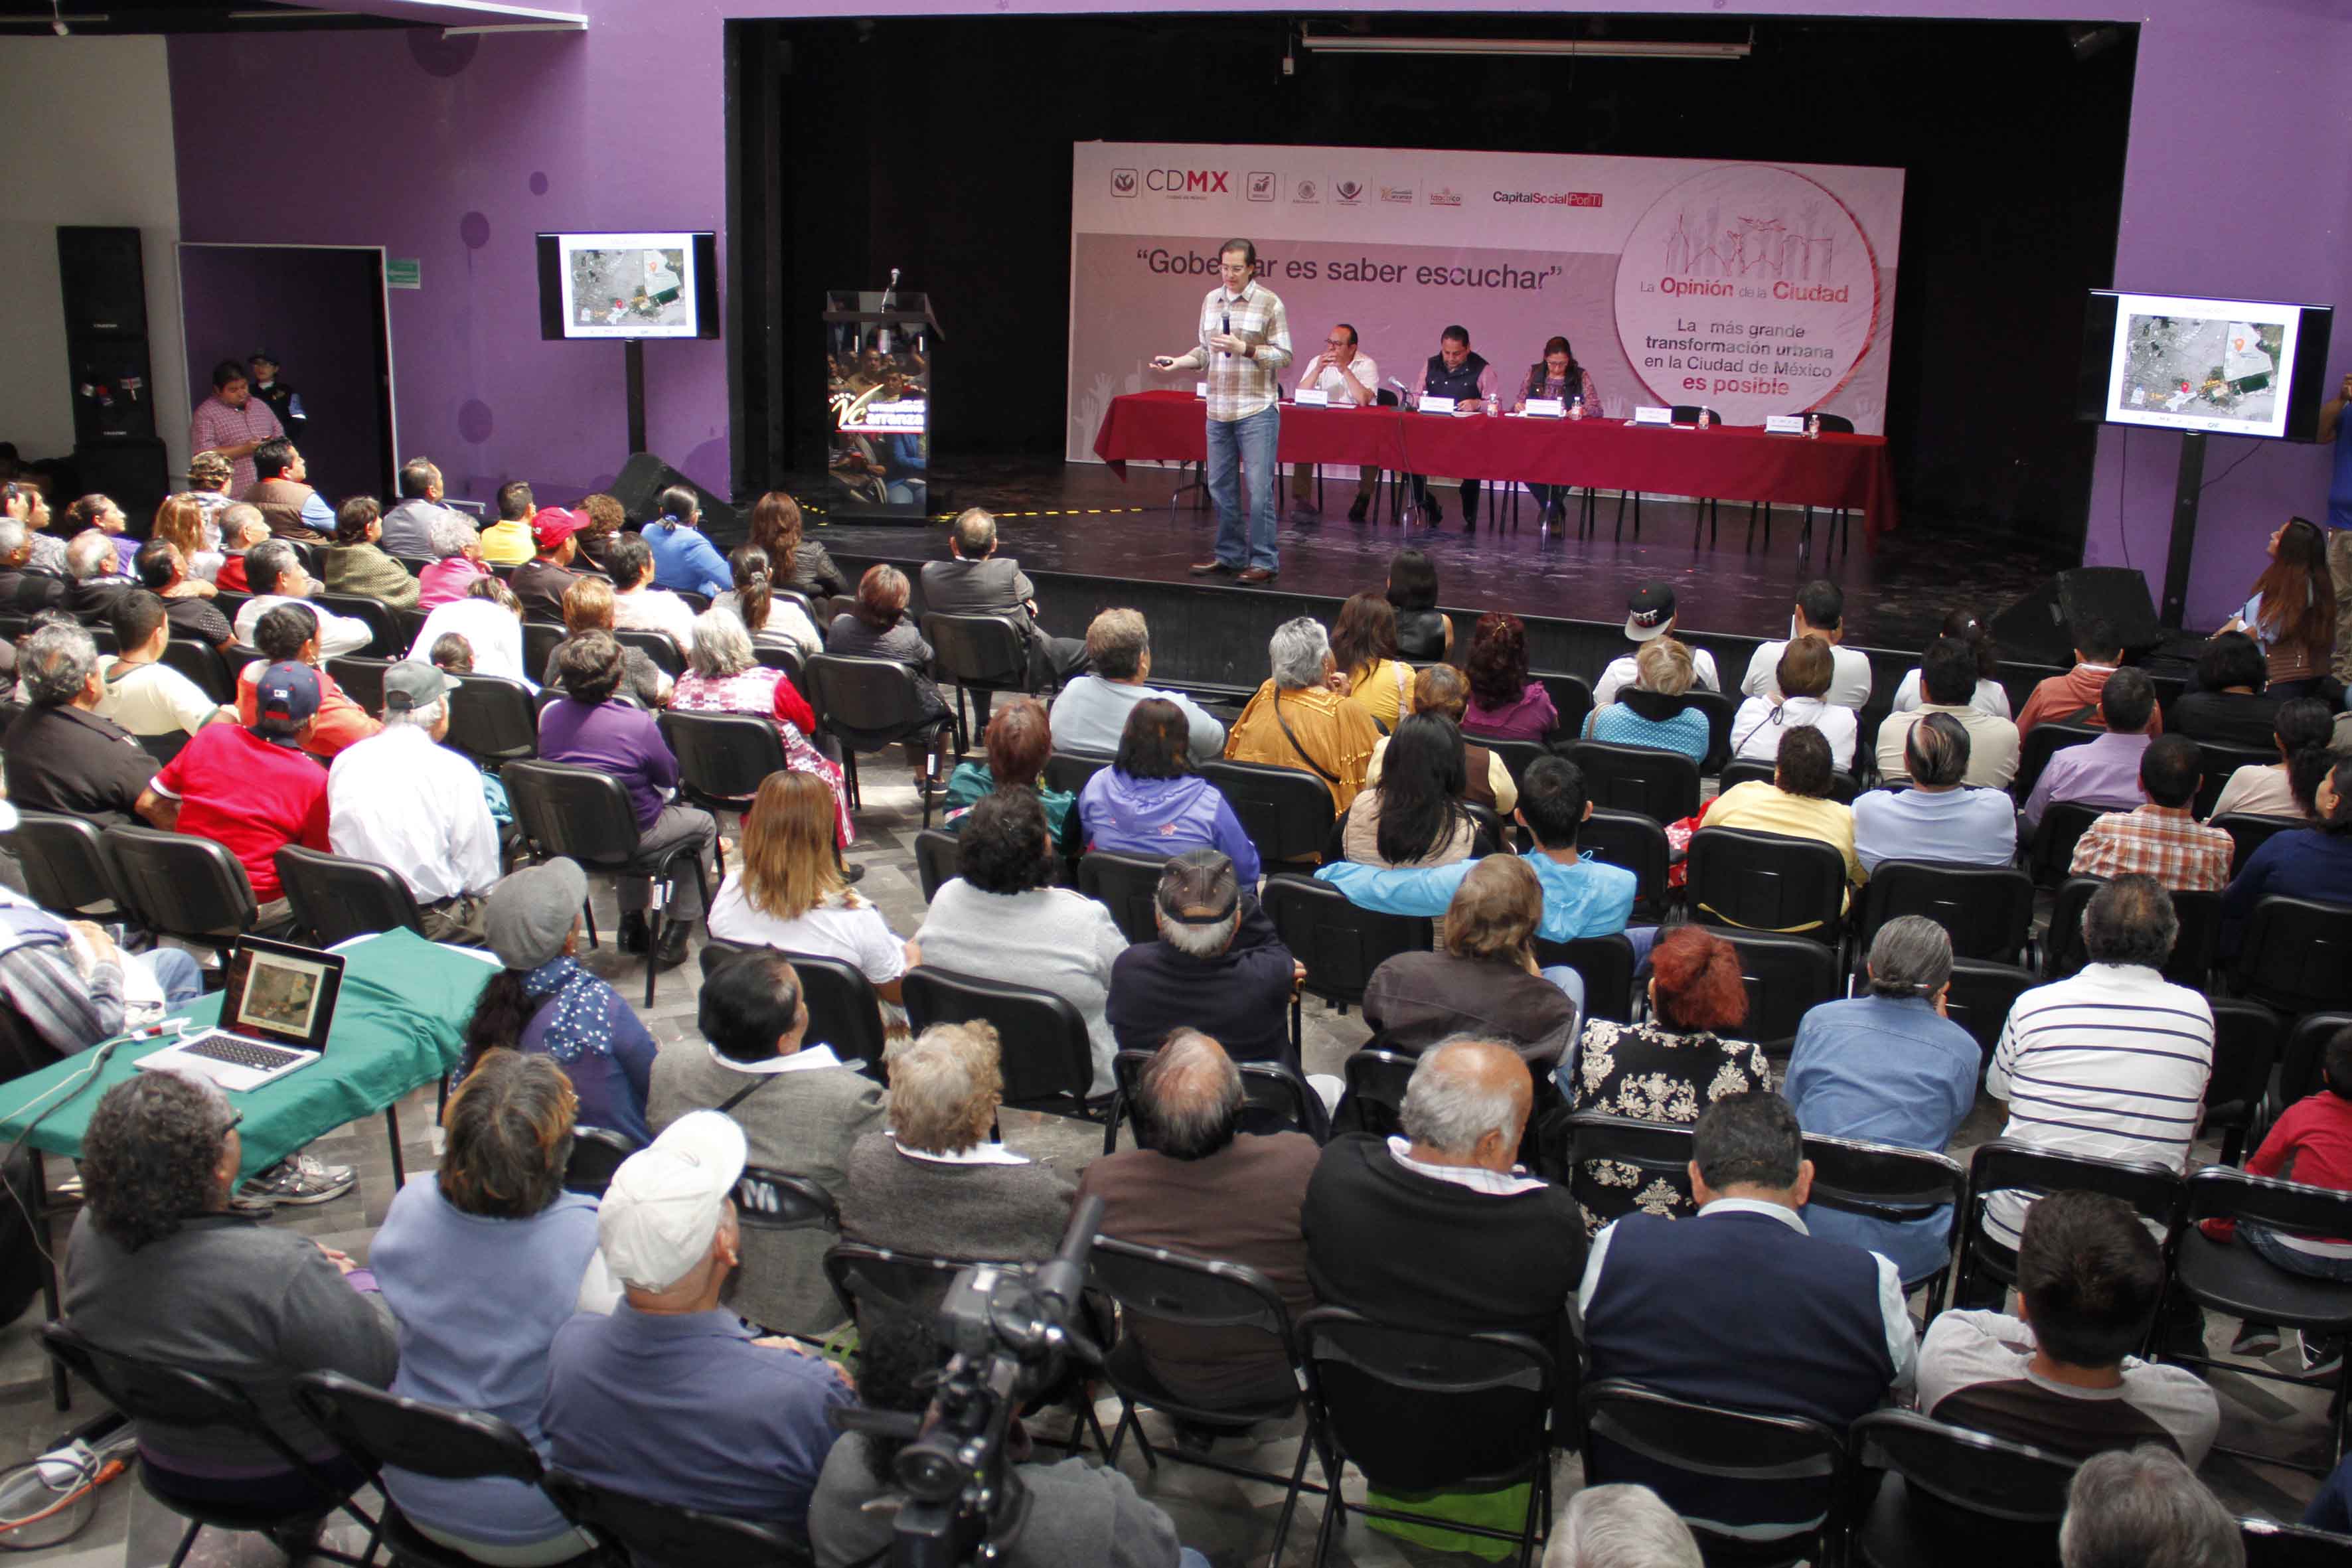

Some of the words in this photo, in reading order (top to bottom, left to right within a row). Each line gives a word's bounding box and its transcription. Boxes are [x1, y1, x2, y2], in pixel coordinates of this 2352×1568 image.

[1146, 169, 1229, 193] CDMX
[1137, 248, 1278, 277] “Gobear
[1286, 260, 1318, 279] es
[1327, 258, 1408, 283] saber
[1640, 281, 1655, 292] La
[1660, 276, 1733, 297] Opinión
[1772, 281, 1849, 303] Ciudad
[1678, 318, 1697, 332] La
[1710, 320, 1744, 335] más
[1749, 325, 1806, 339] grande
[1646, 335, 1770, 355] transformación
[1776, 345, 1834, 359] urbana
[1644, 357, 1664, 368] en
[1668, 355, 1682, 369] la
[1687, 356, 1743, 373] Ciudad
[1749, 361, 1768, 374] de
[1773, 362, 1832, 378] México
[1683, 377, 1707, 391] es
[1713, 377, 1790, 396] posible
